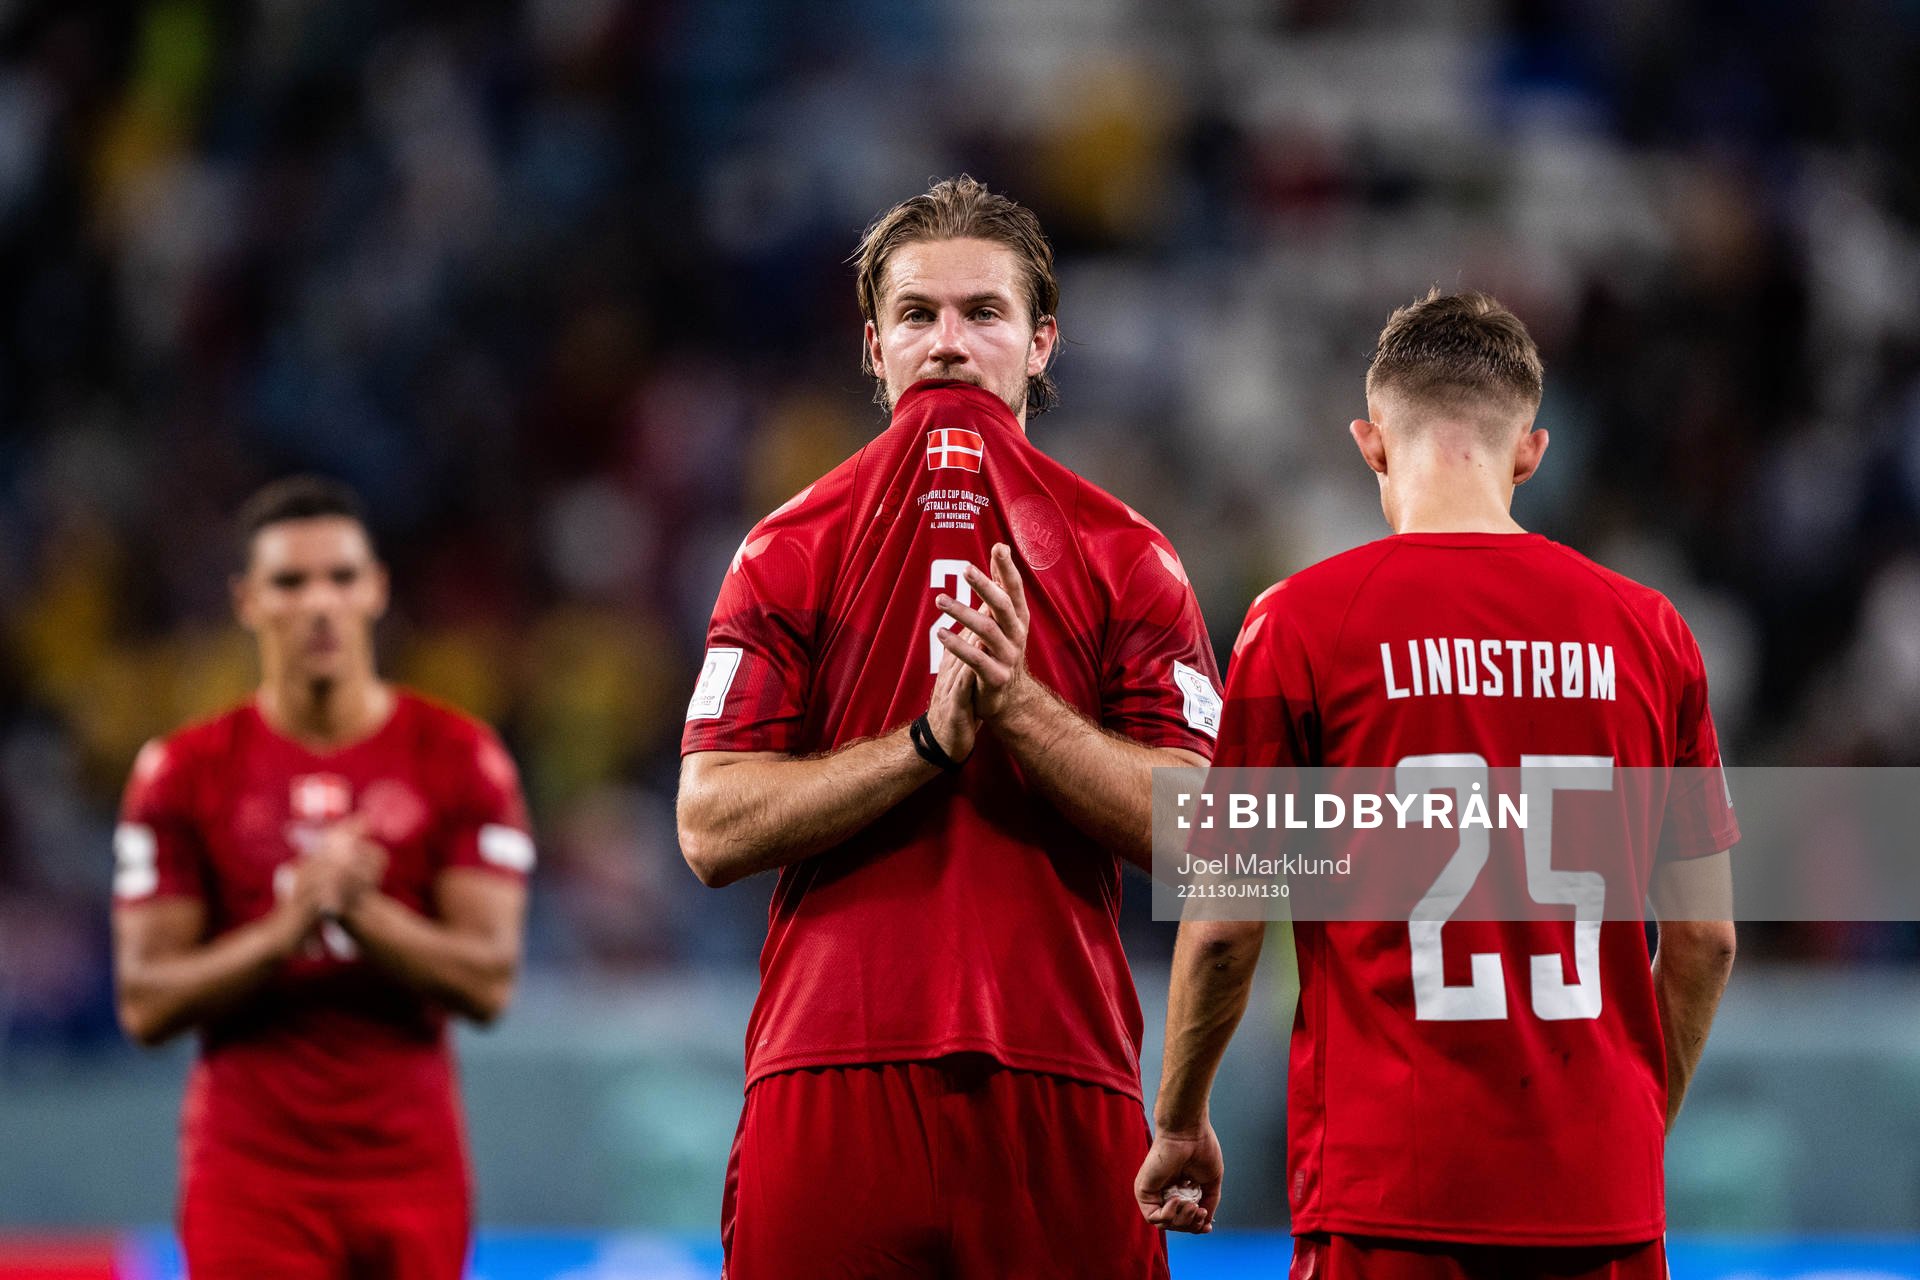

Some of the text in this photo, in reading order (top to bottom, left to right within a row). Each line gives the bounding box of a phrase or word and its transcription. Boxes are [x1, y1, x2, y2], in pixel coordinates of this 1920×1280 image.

[947, 489, 960, 499] CUP
[974, 494, 990, 507] 2022
[946, 512, 971, 520] NOVEMBER
[937, 521, 955, 529] JANOUB
[955, 521, 975, 530] STADIUM
[1380, 637, 1616, 701] LINDSTRØM
[1395, 753, 1614, 1020] 25
